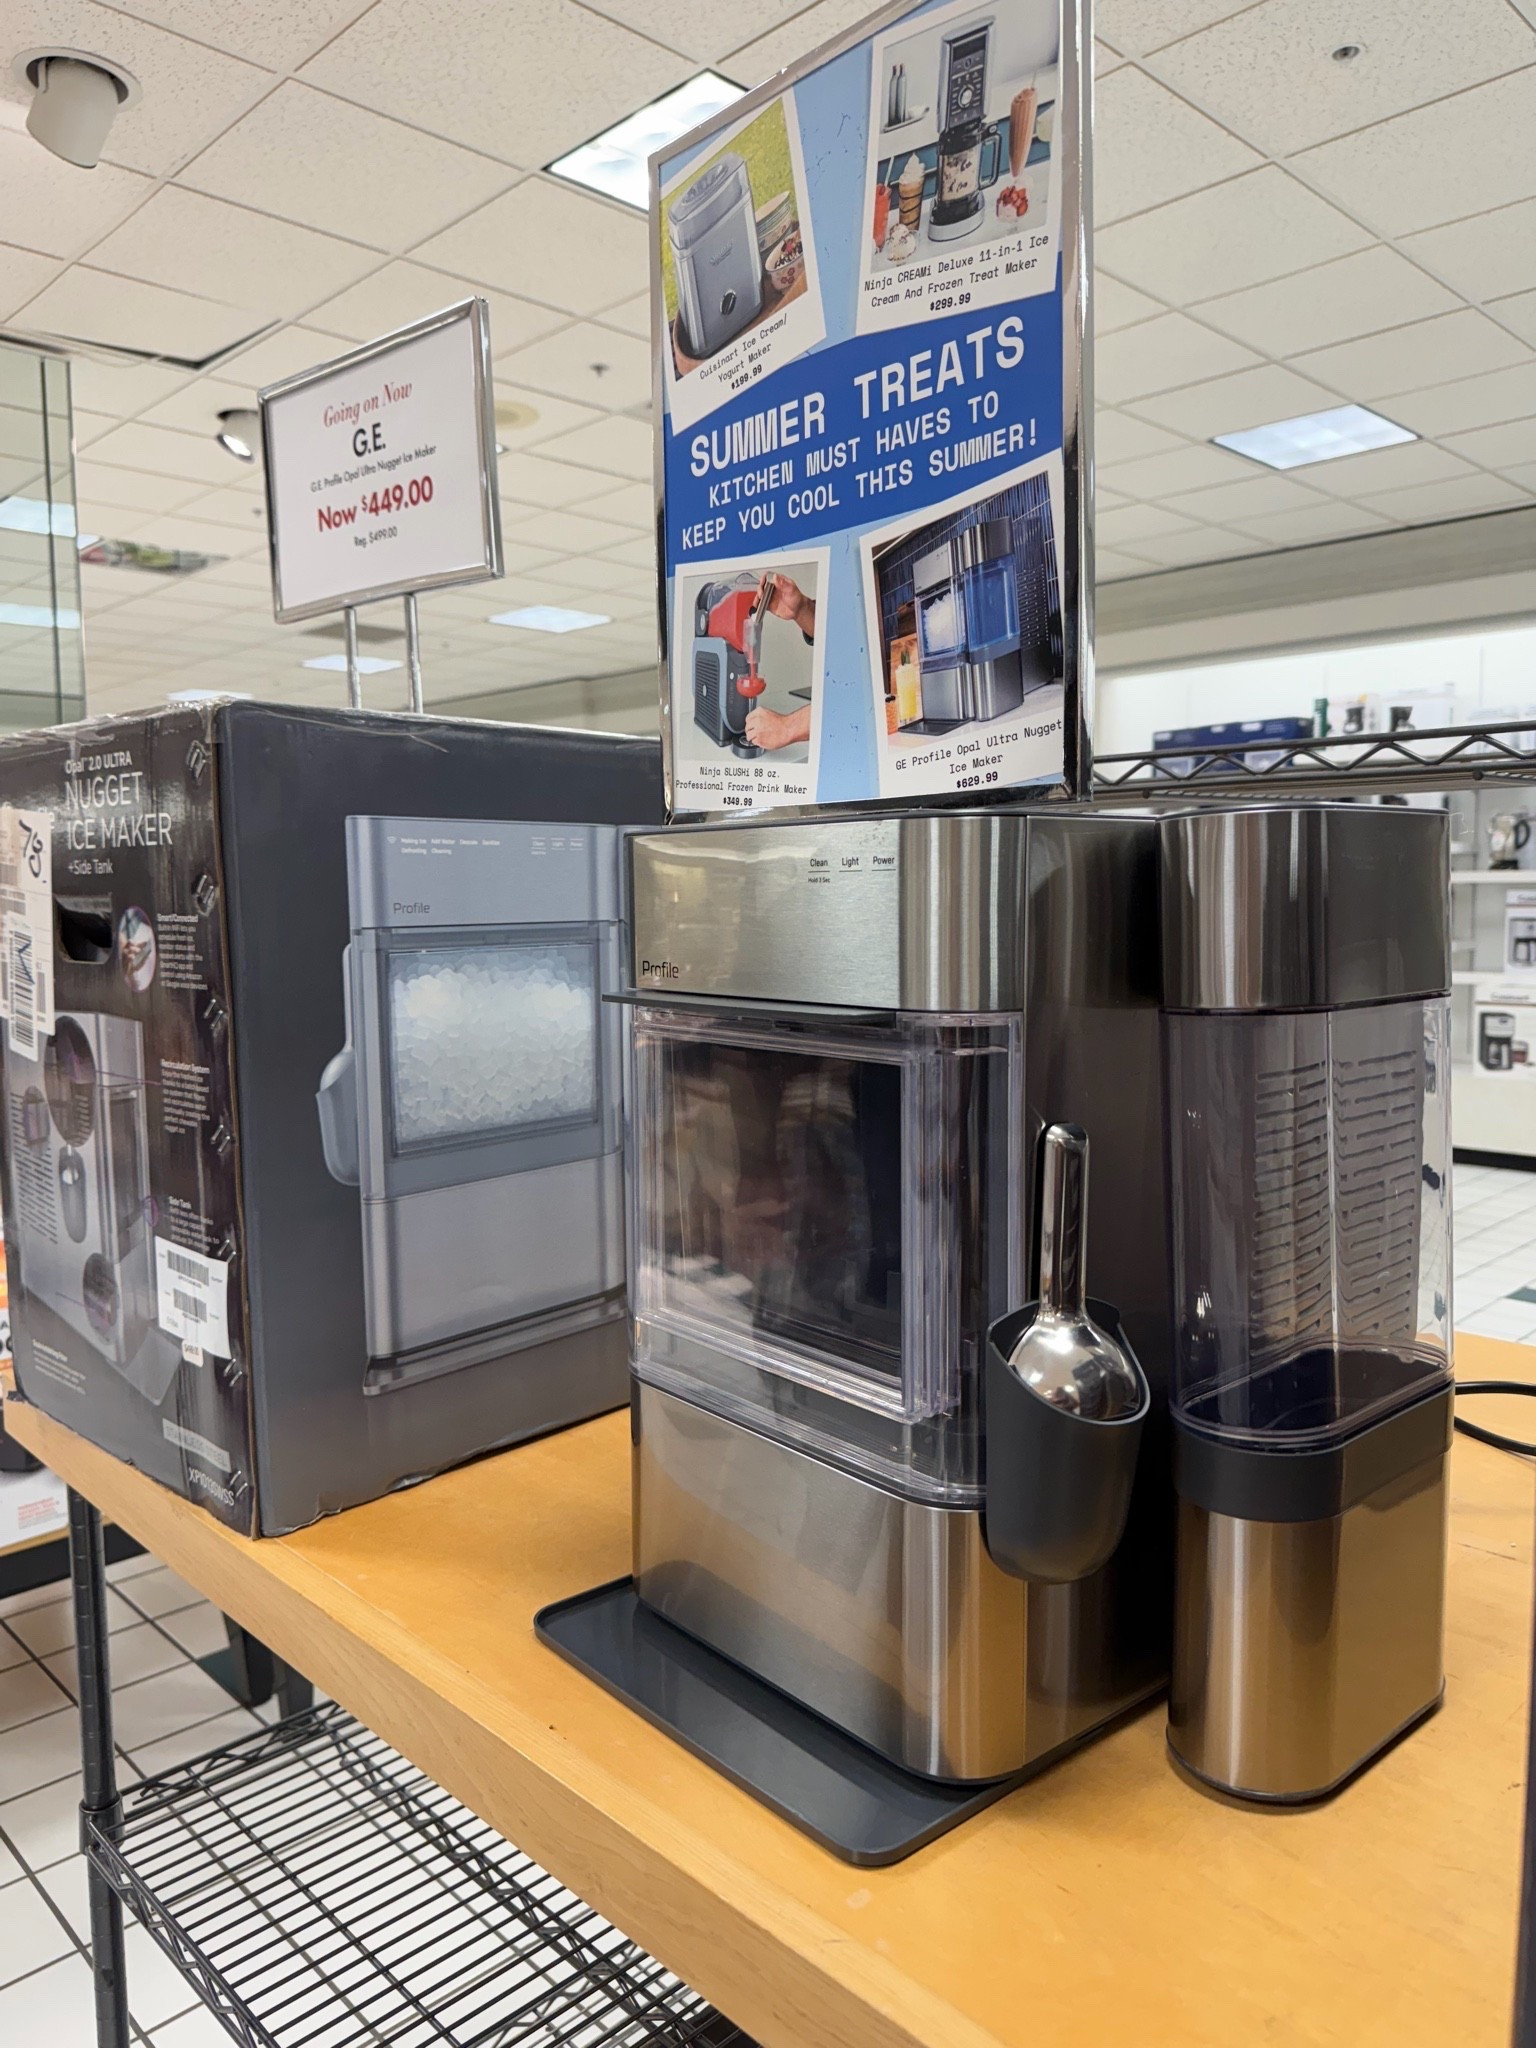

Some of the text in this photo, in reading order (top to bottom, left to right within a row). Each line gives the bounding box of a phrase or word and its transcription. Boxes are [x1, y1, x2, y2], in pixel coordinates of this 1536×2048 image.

[864, 235, 1049, 292] Ninja CREAMi Deluxe 11-in-1 Ice
[871, 257, 1038, 308] Cream And Frozen Treat Maker
[930, 292, 971, 311] $299.99
[700, 313, 787, 380] Cuisinart Ice Cream/
[718, 343, 771, 383] Yogurt Maker
[731, 364, 762, 390] $199.99
[324, 382, 412, 427] Going on Now
[690, 316, 1024, 477] SUMMER TREATS
[353, 422, 386, 457] G.E.
[709, 390, 999, 509] KITCHEN MUST HAVES TO
[324, 474, 343, 488] Profile
[344, 468, 359, 483] Opal
[361, 464, 376, 477] Ultra
[377, 456, 402, 471] Nugget
[403, 453, 413, 464] Ice
[414, 444, 437, 459] Maker
[682, 418, 1036, 550] KEEP YOU COOL THIS SUMMER!
[317, 475, 433, 532] Now $449.00
[354, 526, 398, 548] Reg. $499.00
[896, 718, 1062, 771] GE Profile Opal Ultra Nugget
[88, 756, 102, 771] 2.0
[104, 750, 133, 768] ULTRA
[700, 767, 780, 778] Ninja SLUSHi 88 oz.
[950, 753, 1003, 775] Ice Maker
[65, 771, 143, 810] NUGGET
[675, 780, 808, 795] Professional Frozen Drink Maker
[956, 771, 998, 789] $629.99
[723, 797, 753, 806] $349.99
[67, 812, 173, 850] ICE MAKER
[68, 858, 114, 875] +Side Tank
[810, 858, 828, 867] Clean
[842, 857, 859, 868] Light
[873, 856, 895, 865] Power
[393, 902, 430, 914] Profile
[642, 961, 679, 979] Profile
